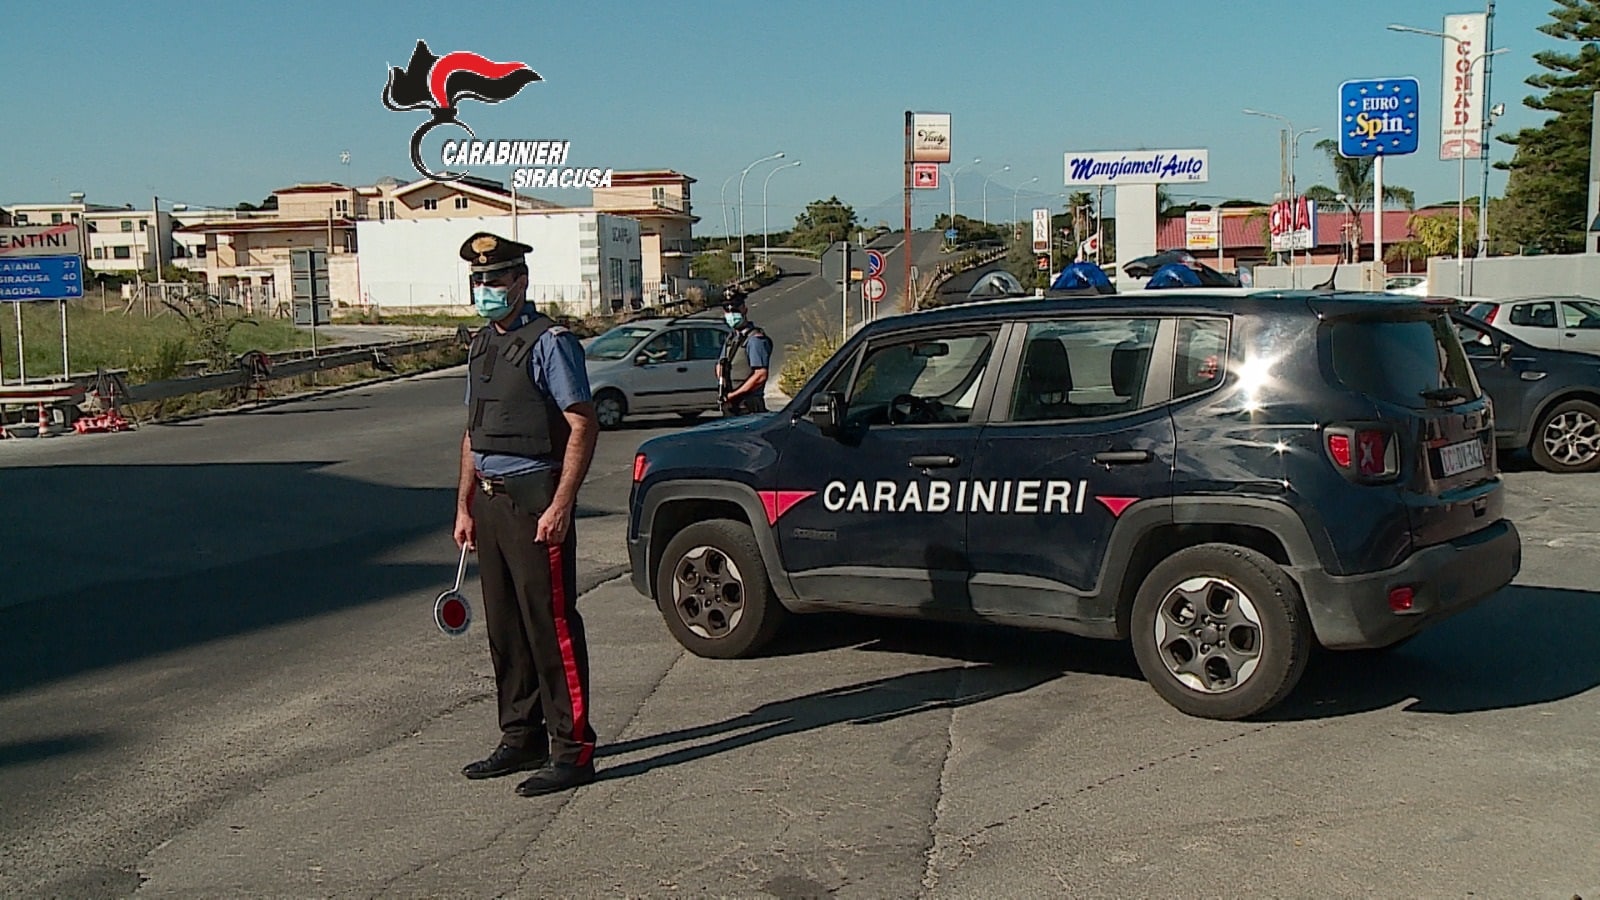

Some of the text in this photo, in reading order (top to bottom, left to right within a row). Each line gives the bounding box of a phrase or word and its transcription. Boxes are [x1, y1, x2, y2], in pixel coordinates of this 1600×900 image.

[1363, 97, 1399, 111] EURO
[1355, 112, 1403, 140] Spin
[1070, 154, 1203, 180] Mangiameli Auto
[1036, 211, 1045, 238] BAR
[62, 273, 77, 281] 40
[823, 480, 1088, 514] CARABINIERI
